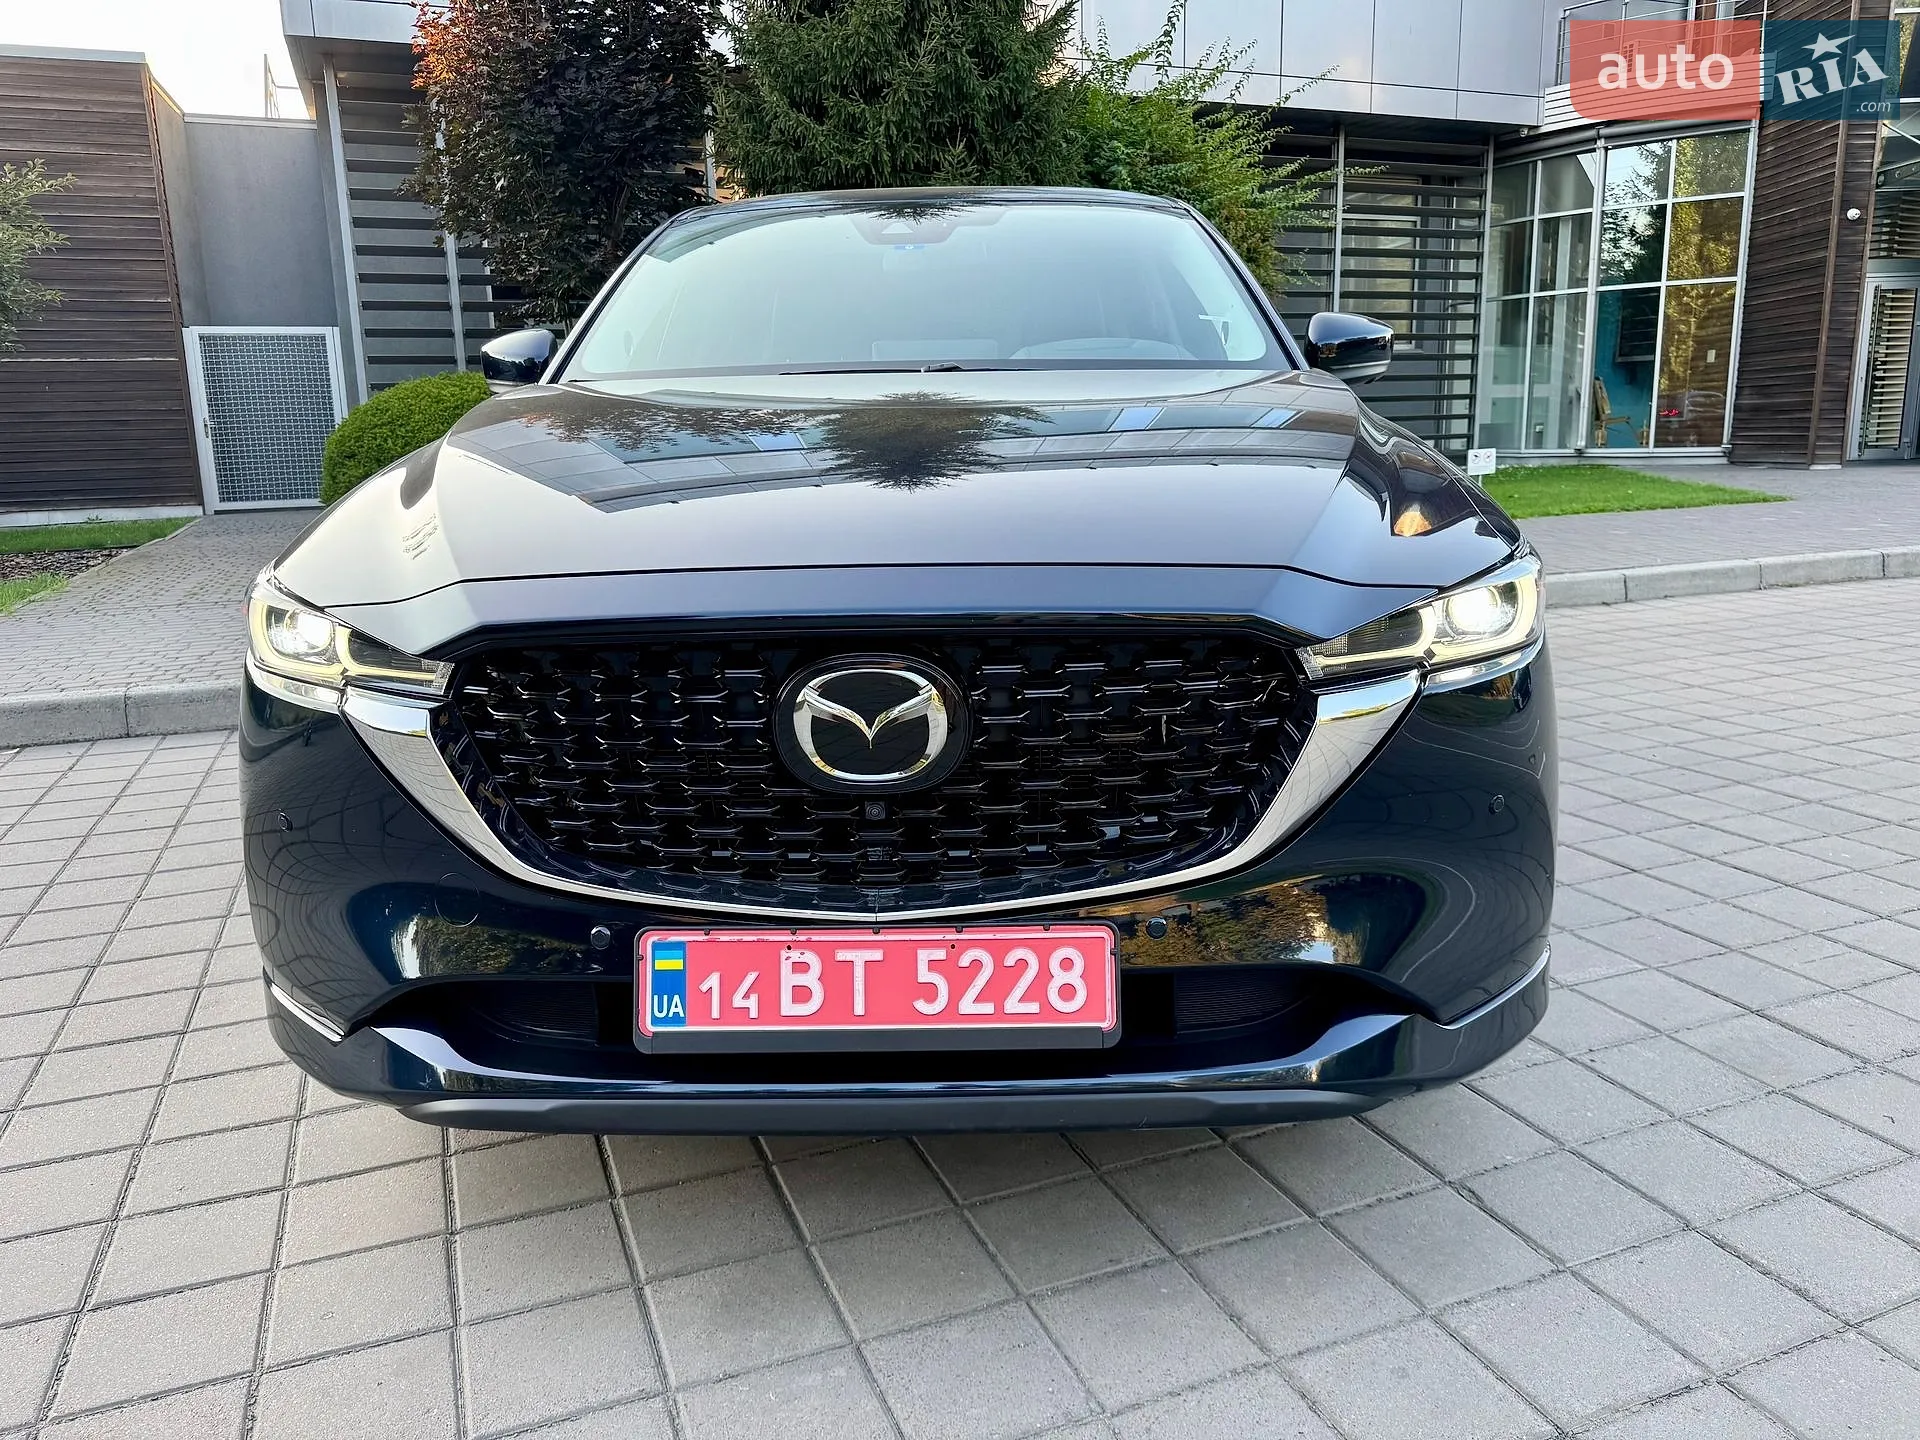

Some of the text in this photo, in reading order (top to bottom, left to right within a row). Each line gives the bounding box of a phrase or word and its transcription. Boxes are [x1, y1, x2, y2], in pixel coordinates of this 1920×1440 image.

[653, 994, 684, 1019] UA
[698, 946, 1088, 1019] 14 BT 5228
